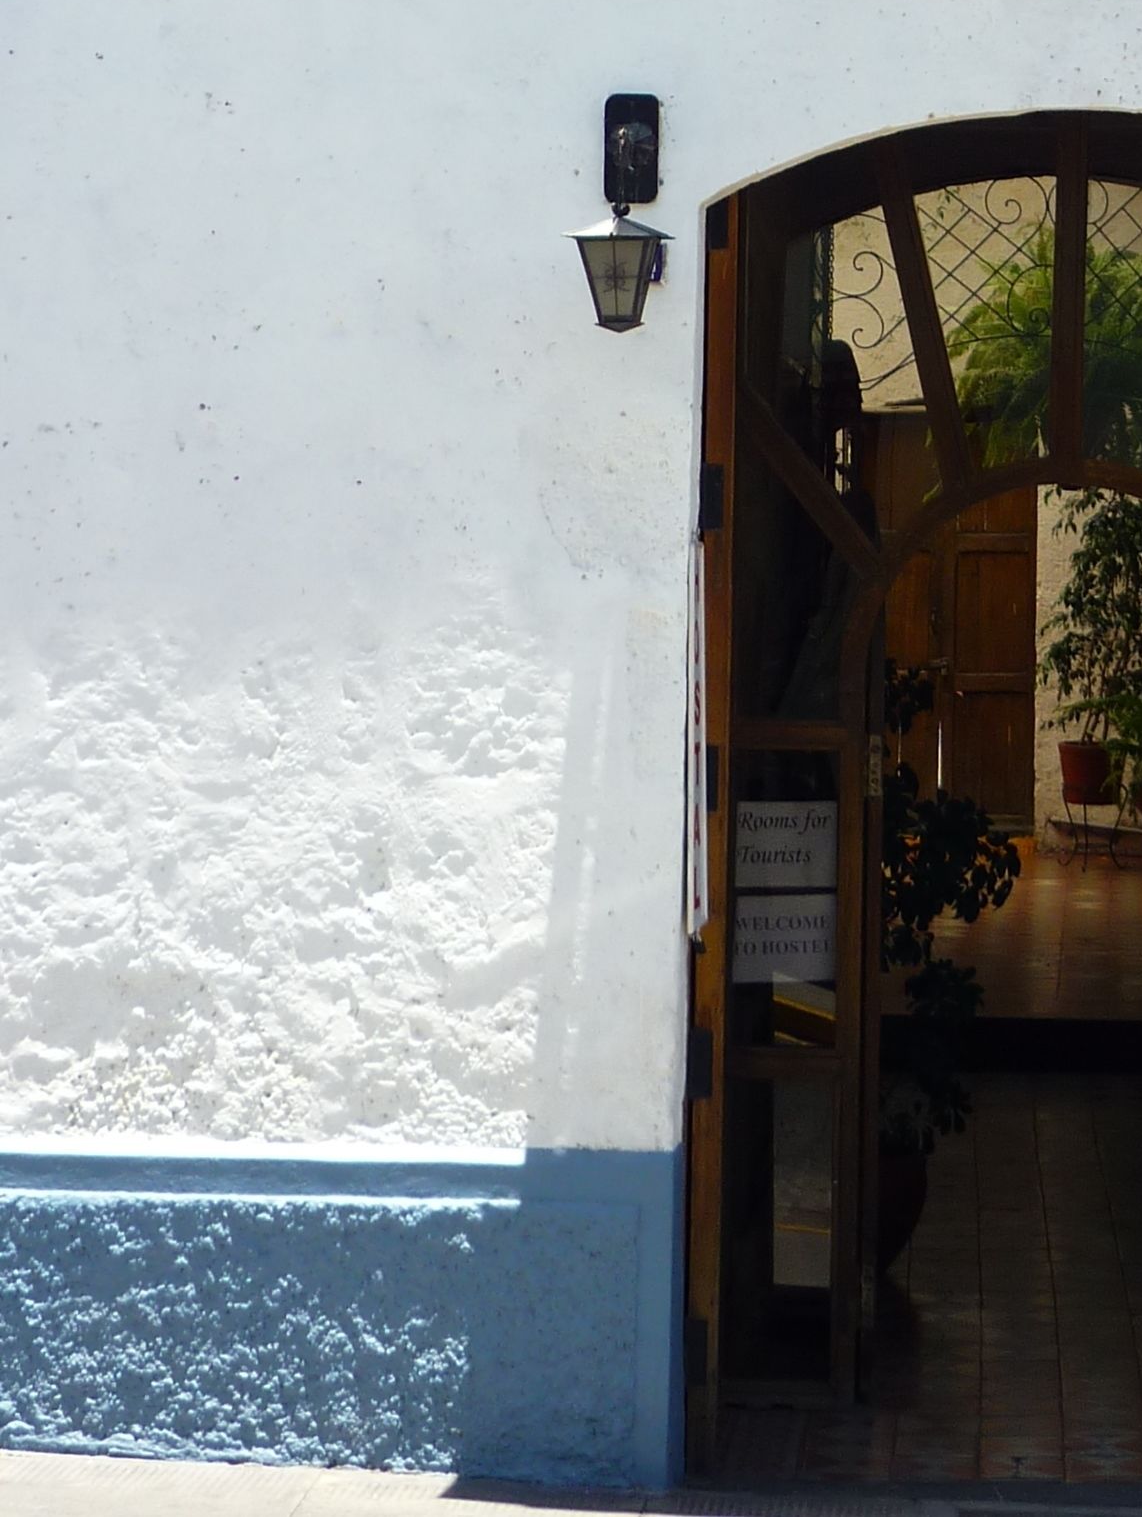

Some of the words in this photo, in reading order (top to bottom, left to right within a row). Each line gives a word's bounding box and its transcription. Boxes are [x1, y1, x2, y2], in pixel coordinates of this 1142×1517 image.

[739, 811, 797, 831] Rooms
[798, 809, 831, 835] for
[736, 844, 812, 863] Tourists
